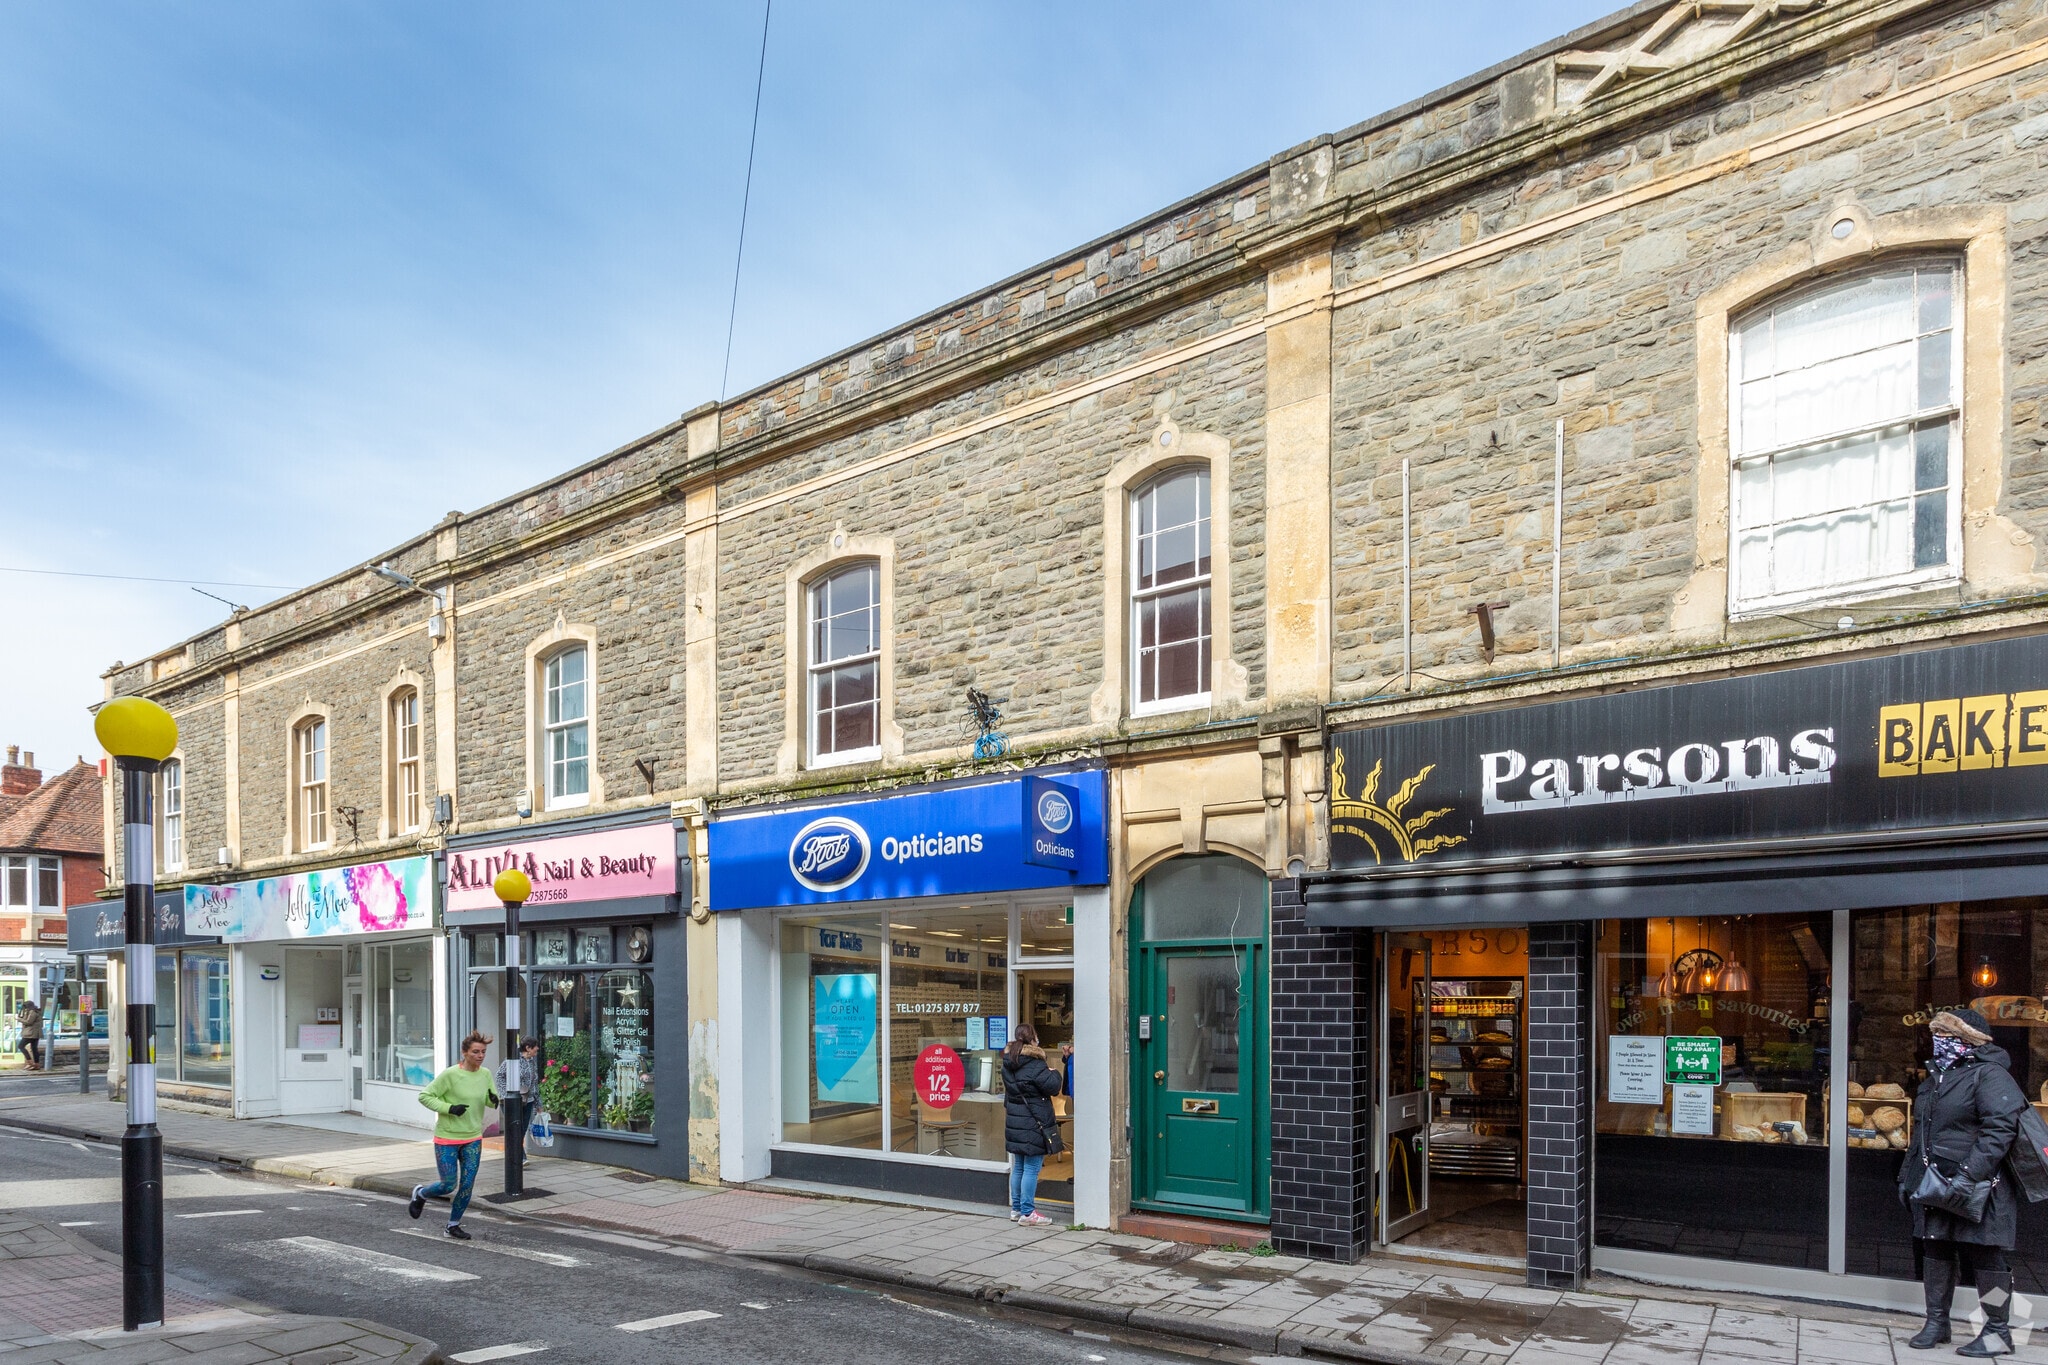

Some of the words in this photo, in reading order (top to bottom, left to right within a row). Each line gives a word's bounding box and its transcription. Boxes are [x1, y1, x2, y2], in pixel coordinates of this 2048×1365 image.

[1883, 704, 2048, 765] BAKE
[1480, 726, 1837, 806] Parsons
[1043, 799, 1068, 823] Boots
[798, 833, 850, 872] Boots
[881, 831, 983, 864] Opticians
[1036, 839, 1075, 859] Opticians
[543, 858, 576, 882] Nail
[581, 857, 595, 878] &
[599, 852, 658, 879] Beauty
[524, 888, 568, 902] 75875668
[285, 884, 311, 930] Lolly
[314, 886, 350, 919] Moo
[198, 916, 231, 929] Moo
[820, 928, 838, 948] for
[840, 931, 863, 952] kids
[892, 940, 906, 957] for
[945, 947, 957, 962] for
[602, 1007, 614, 1015] Nail
[616, 1007, 649, 1016] Extensions
[830, 1005, 860, 1015] OPEN
[896, 1004, 914, 1013] TEL:
[915, 1004, 942, 1013] 01275
[944, 1003, 961, 1013] 877
[963, 1004, 980, 1013] 877
[616, 1017, 637, 1027] Acrylic
[1716, 998, 1810, 1035] savouries
[617, 1027, 637, 1036] Glitter
[637, 1028, 649, 1036] Gel
[612, 1037, 622, 1045] Gel
[623, 1037, 641, 1046] Polish
[934, 1047, 943, 1055] all
[931, 1064, 946, 1072] pairs
[928, 1074, 950, 1092] 1/2
[929, 1091, 951, 1102] price
